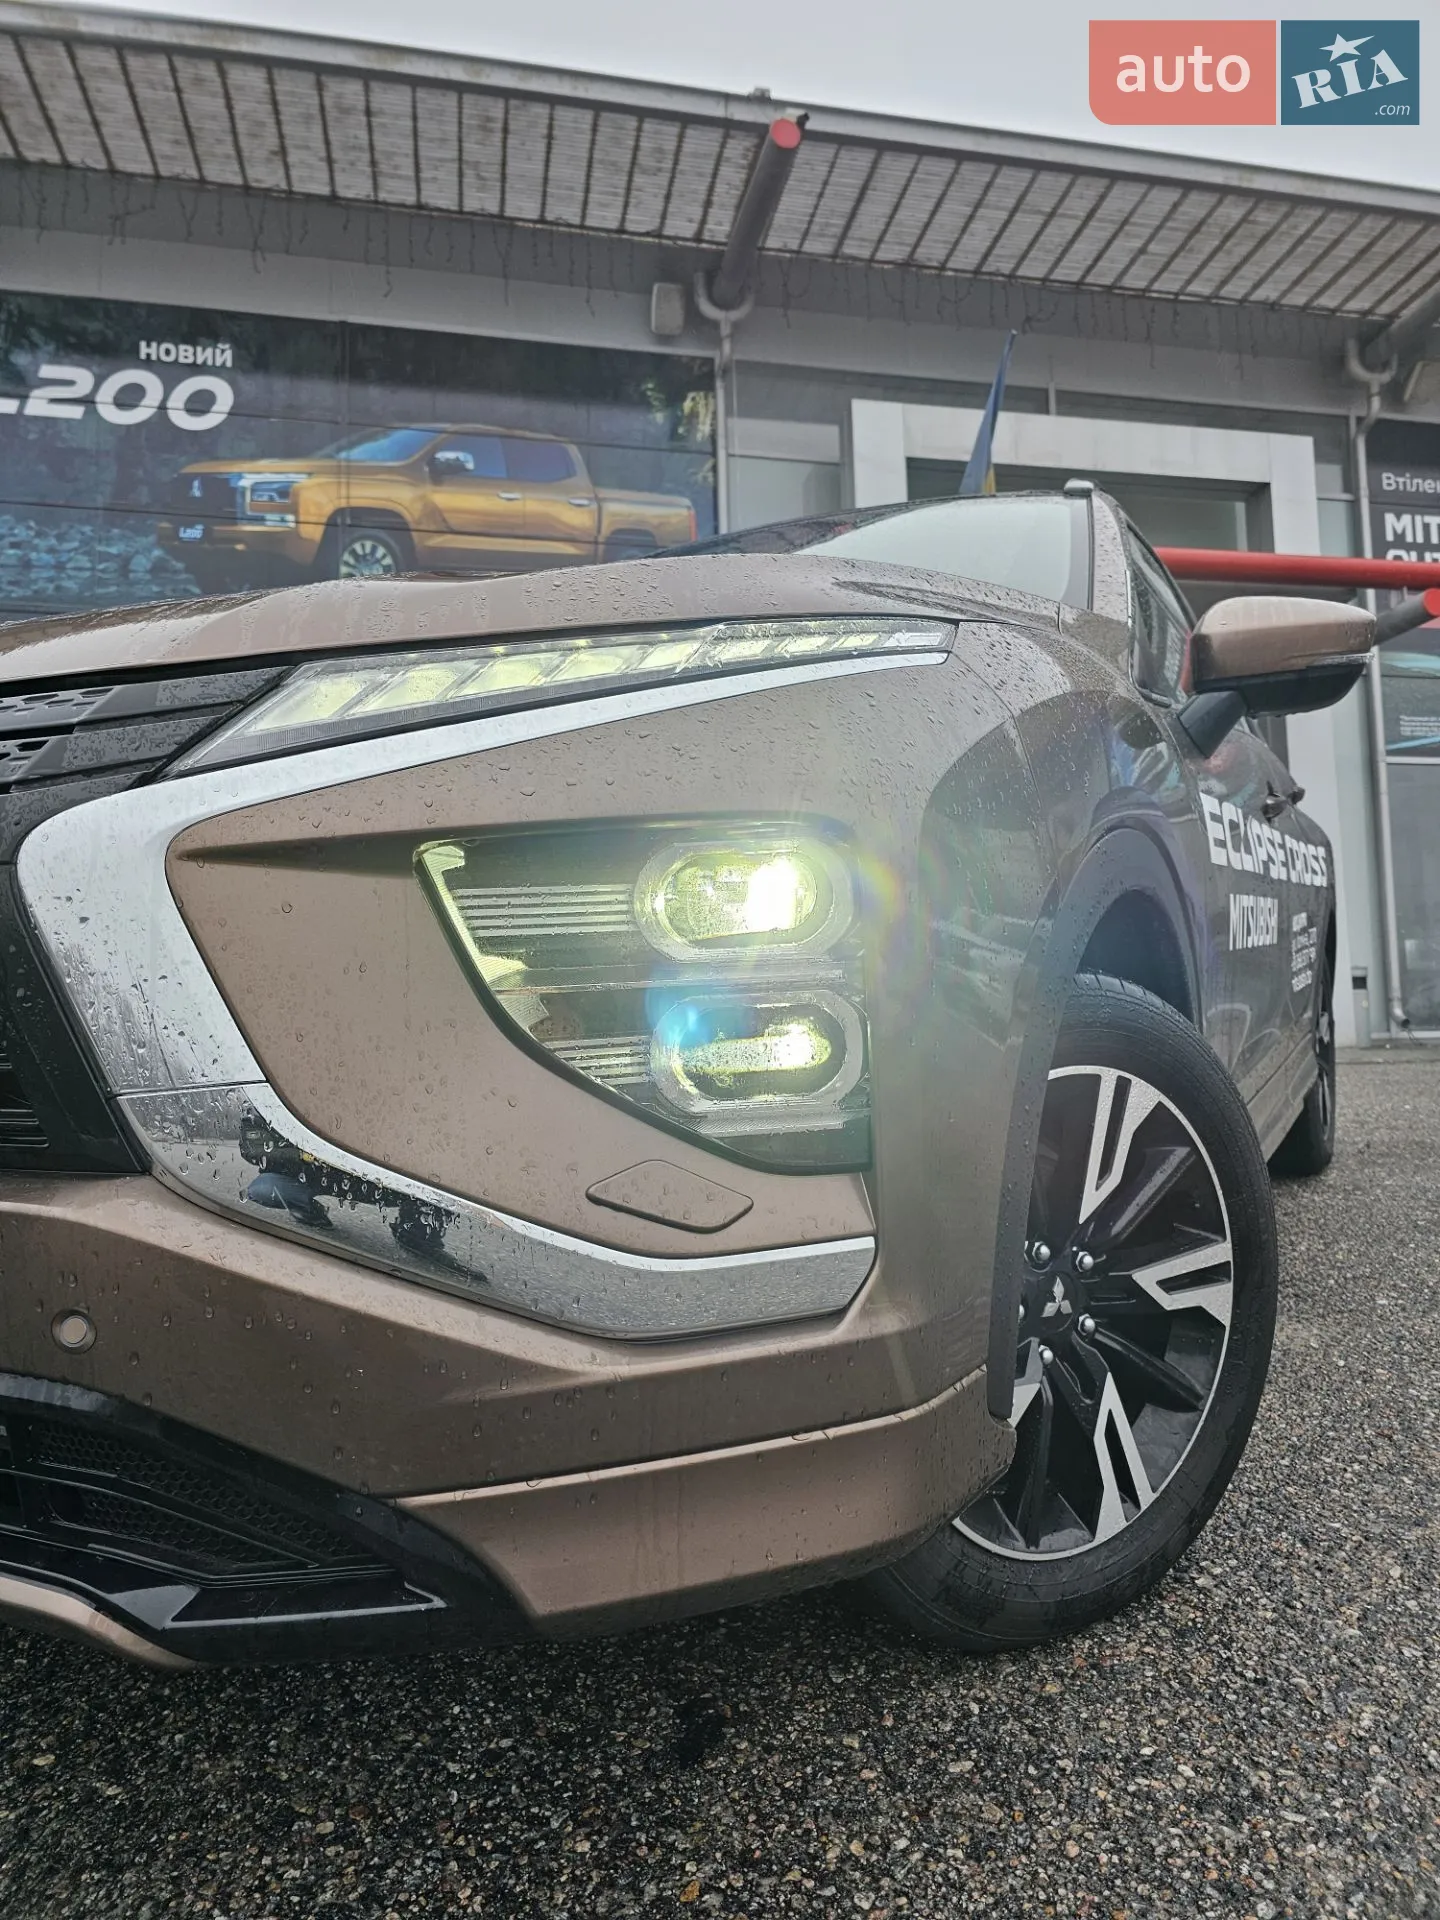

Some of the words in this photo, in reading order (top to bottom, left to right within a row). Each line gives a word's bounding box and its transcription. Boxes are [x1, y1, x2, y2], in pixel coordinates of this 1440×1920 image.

[1381, 471, 1440, 494] Втіле
[1199, 791, 1288, 881] ECLIPSE
[1284, 834, 1328, 888] CROSS
